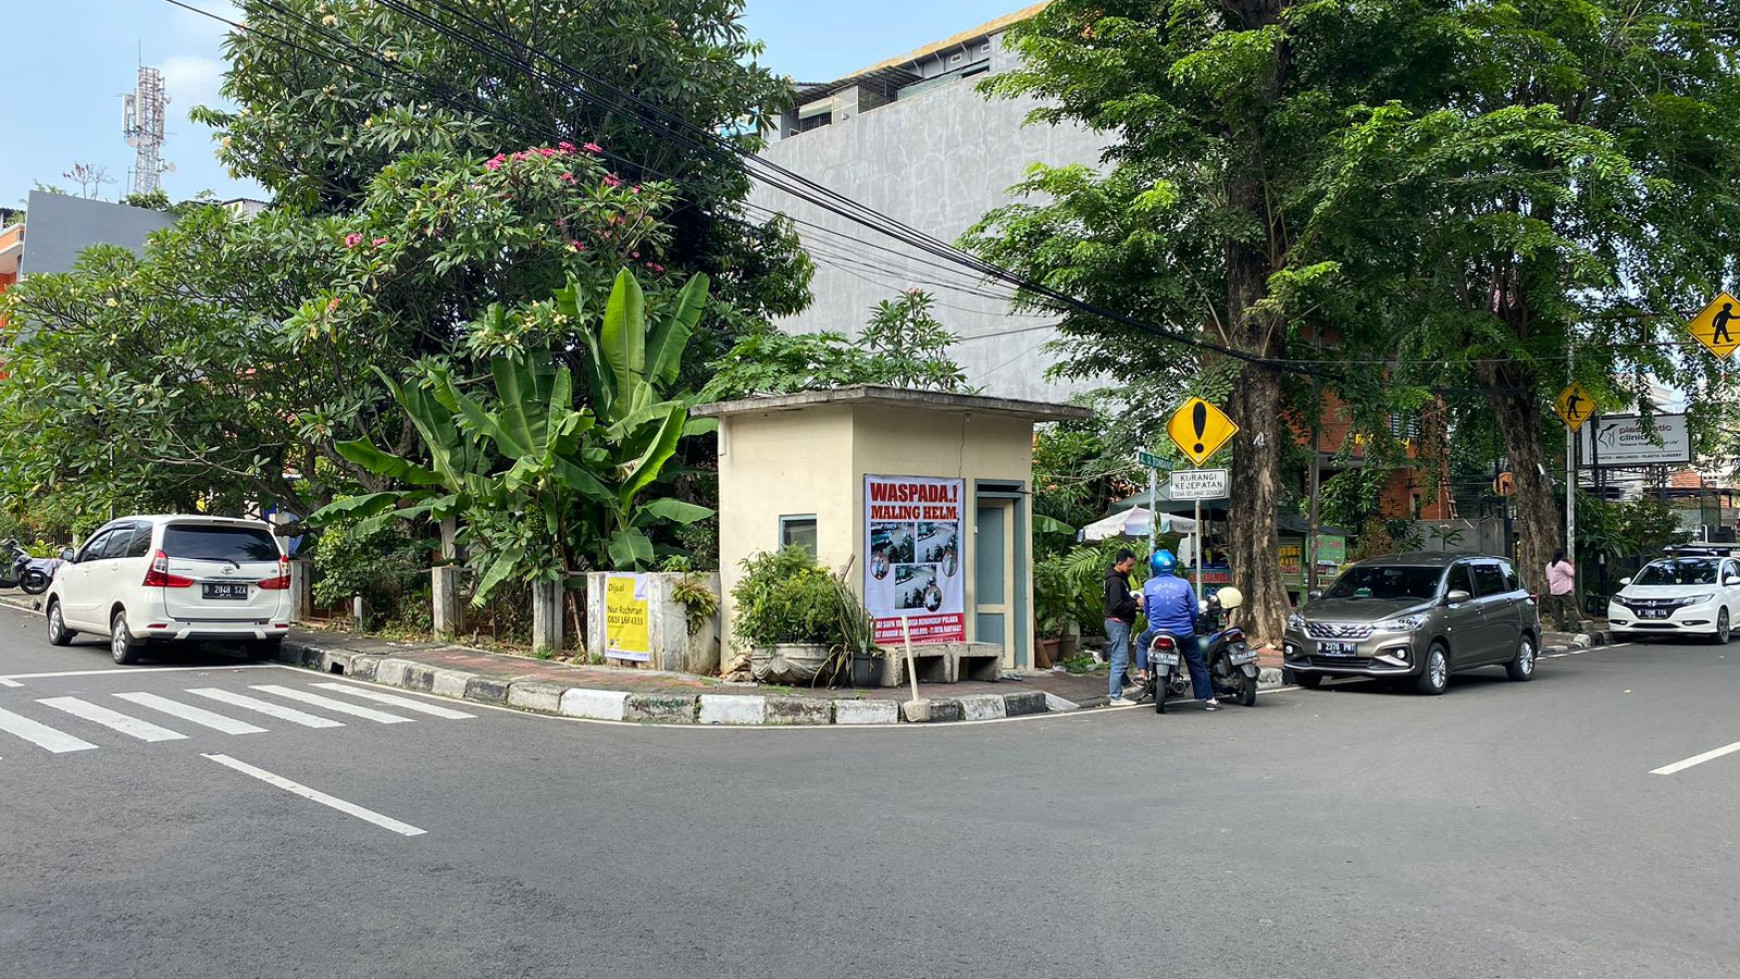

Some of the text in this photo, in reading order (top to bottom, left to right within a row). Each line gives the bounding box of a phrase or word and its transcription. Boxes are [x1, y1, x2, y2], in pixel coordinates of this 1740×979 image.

[1180, 473, 1217, 482] KURANGI
[1175, 481, 1223, 490] KECEPATAN
[871, 505, 958, 520] MALING HELM
[204, 585, 209, 593] B
[608, 583, 625, 594] Dijual
